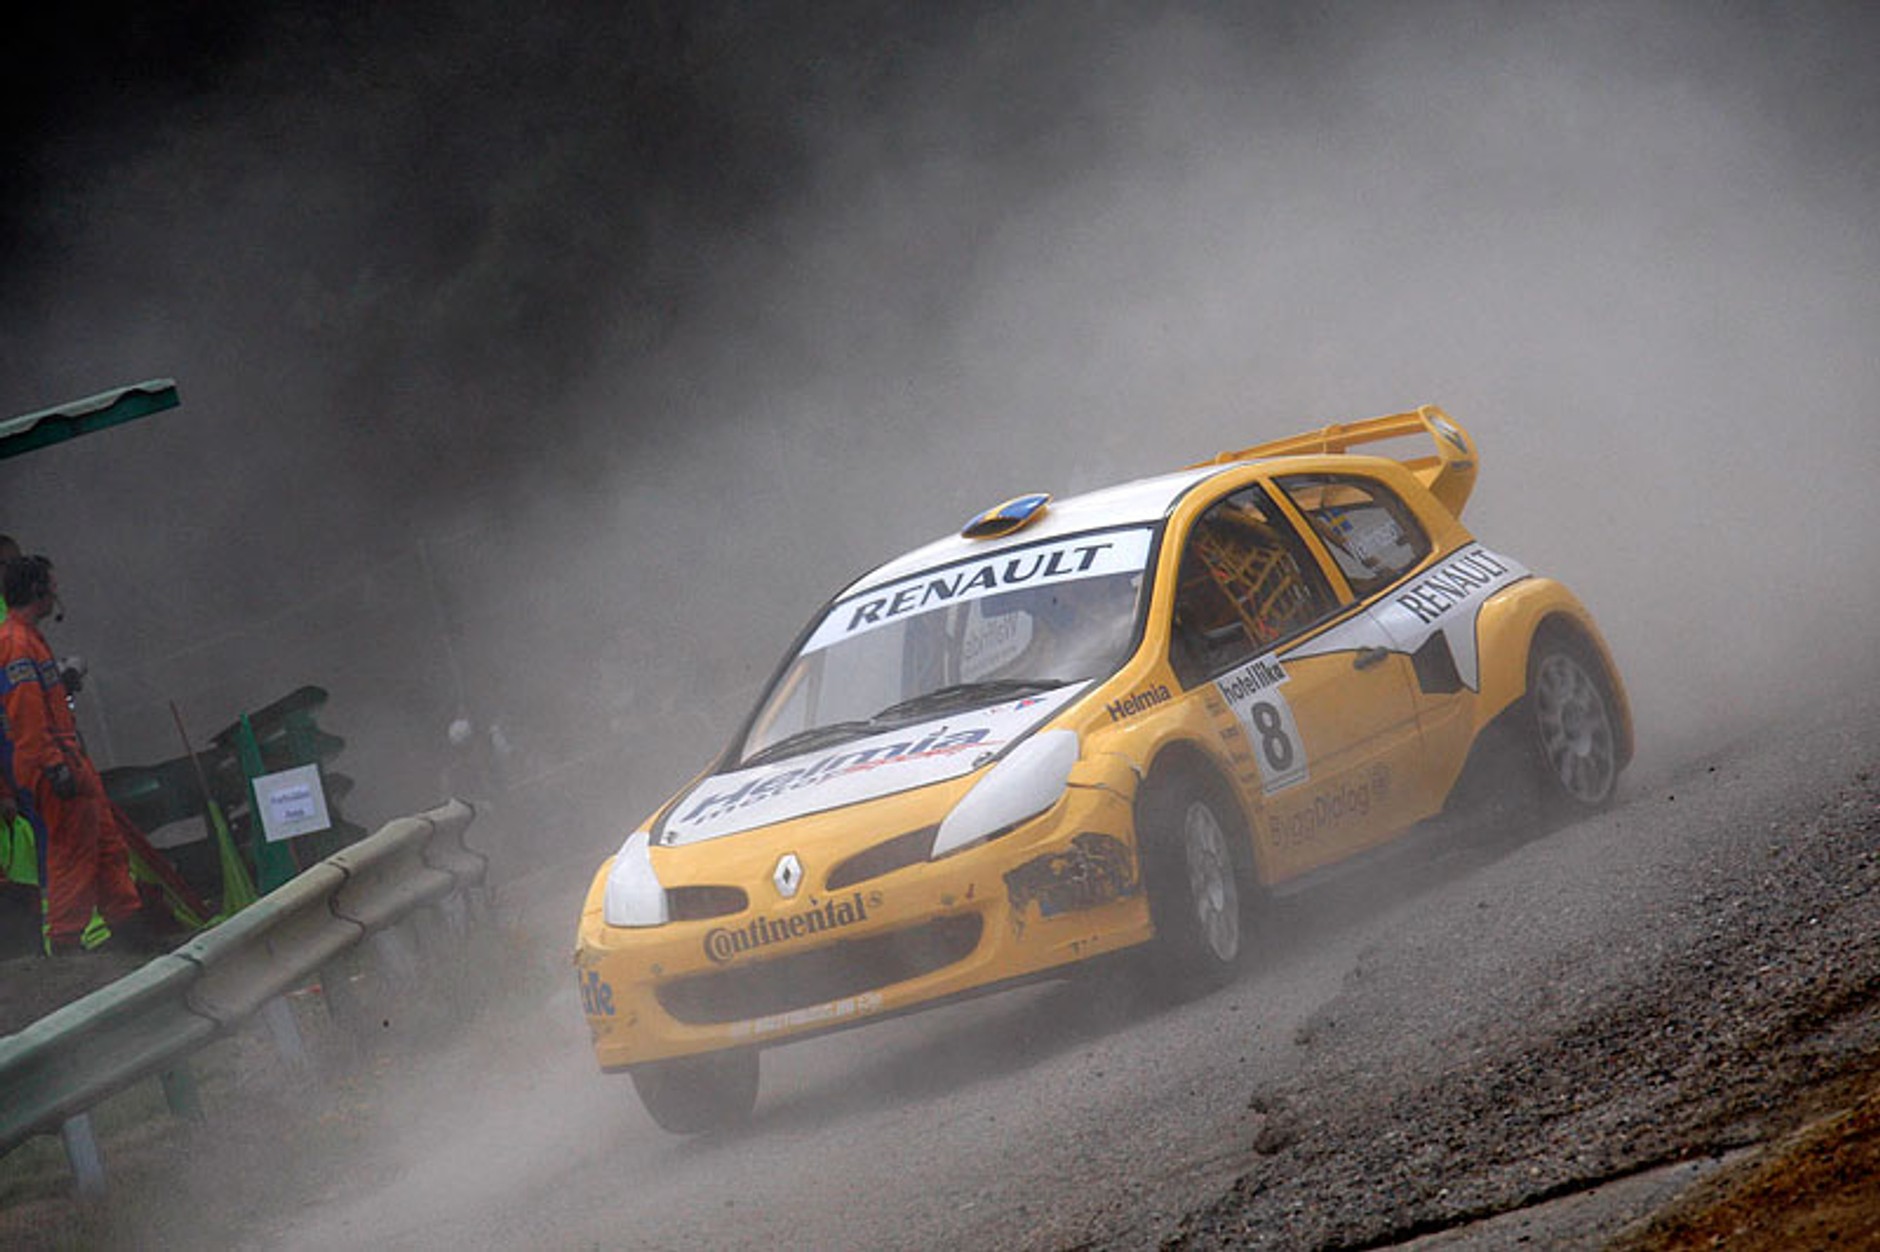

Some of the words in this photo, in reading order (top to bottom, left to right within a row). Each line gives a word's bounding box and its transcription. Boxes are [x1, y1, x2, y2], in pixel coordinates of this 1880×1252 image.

[846, 542, 1114, 632] RENAULT
[1396, 549, 1508, 624] RENAULT
[1105, 683, 1172, 722] Helmia
[1251, 701, 1294, 772] 8
[679, 725, 991, 824] Helmia
[703, 892, 868, 966] Continental
